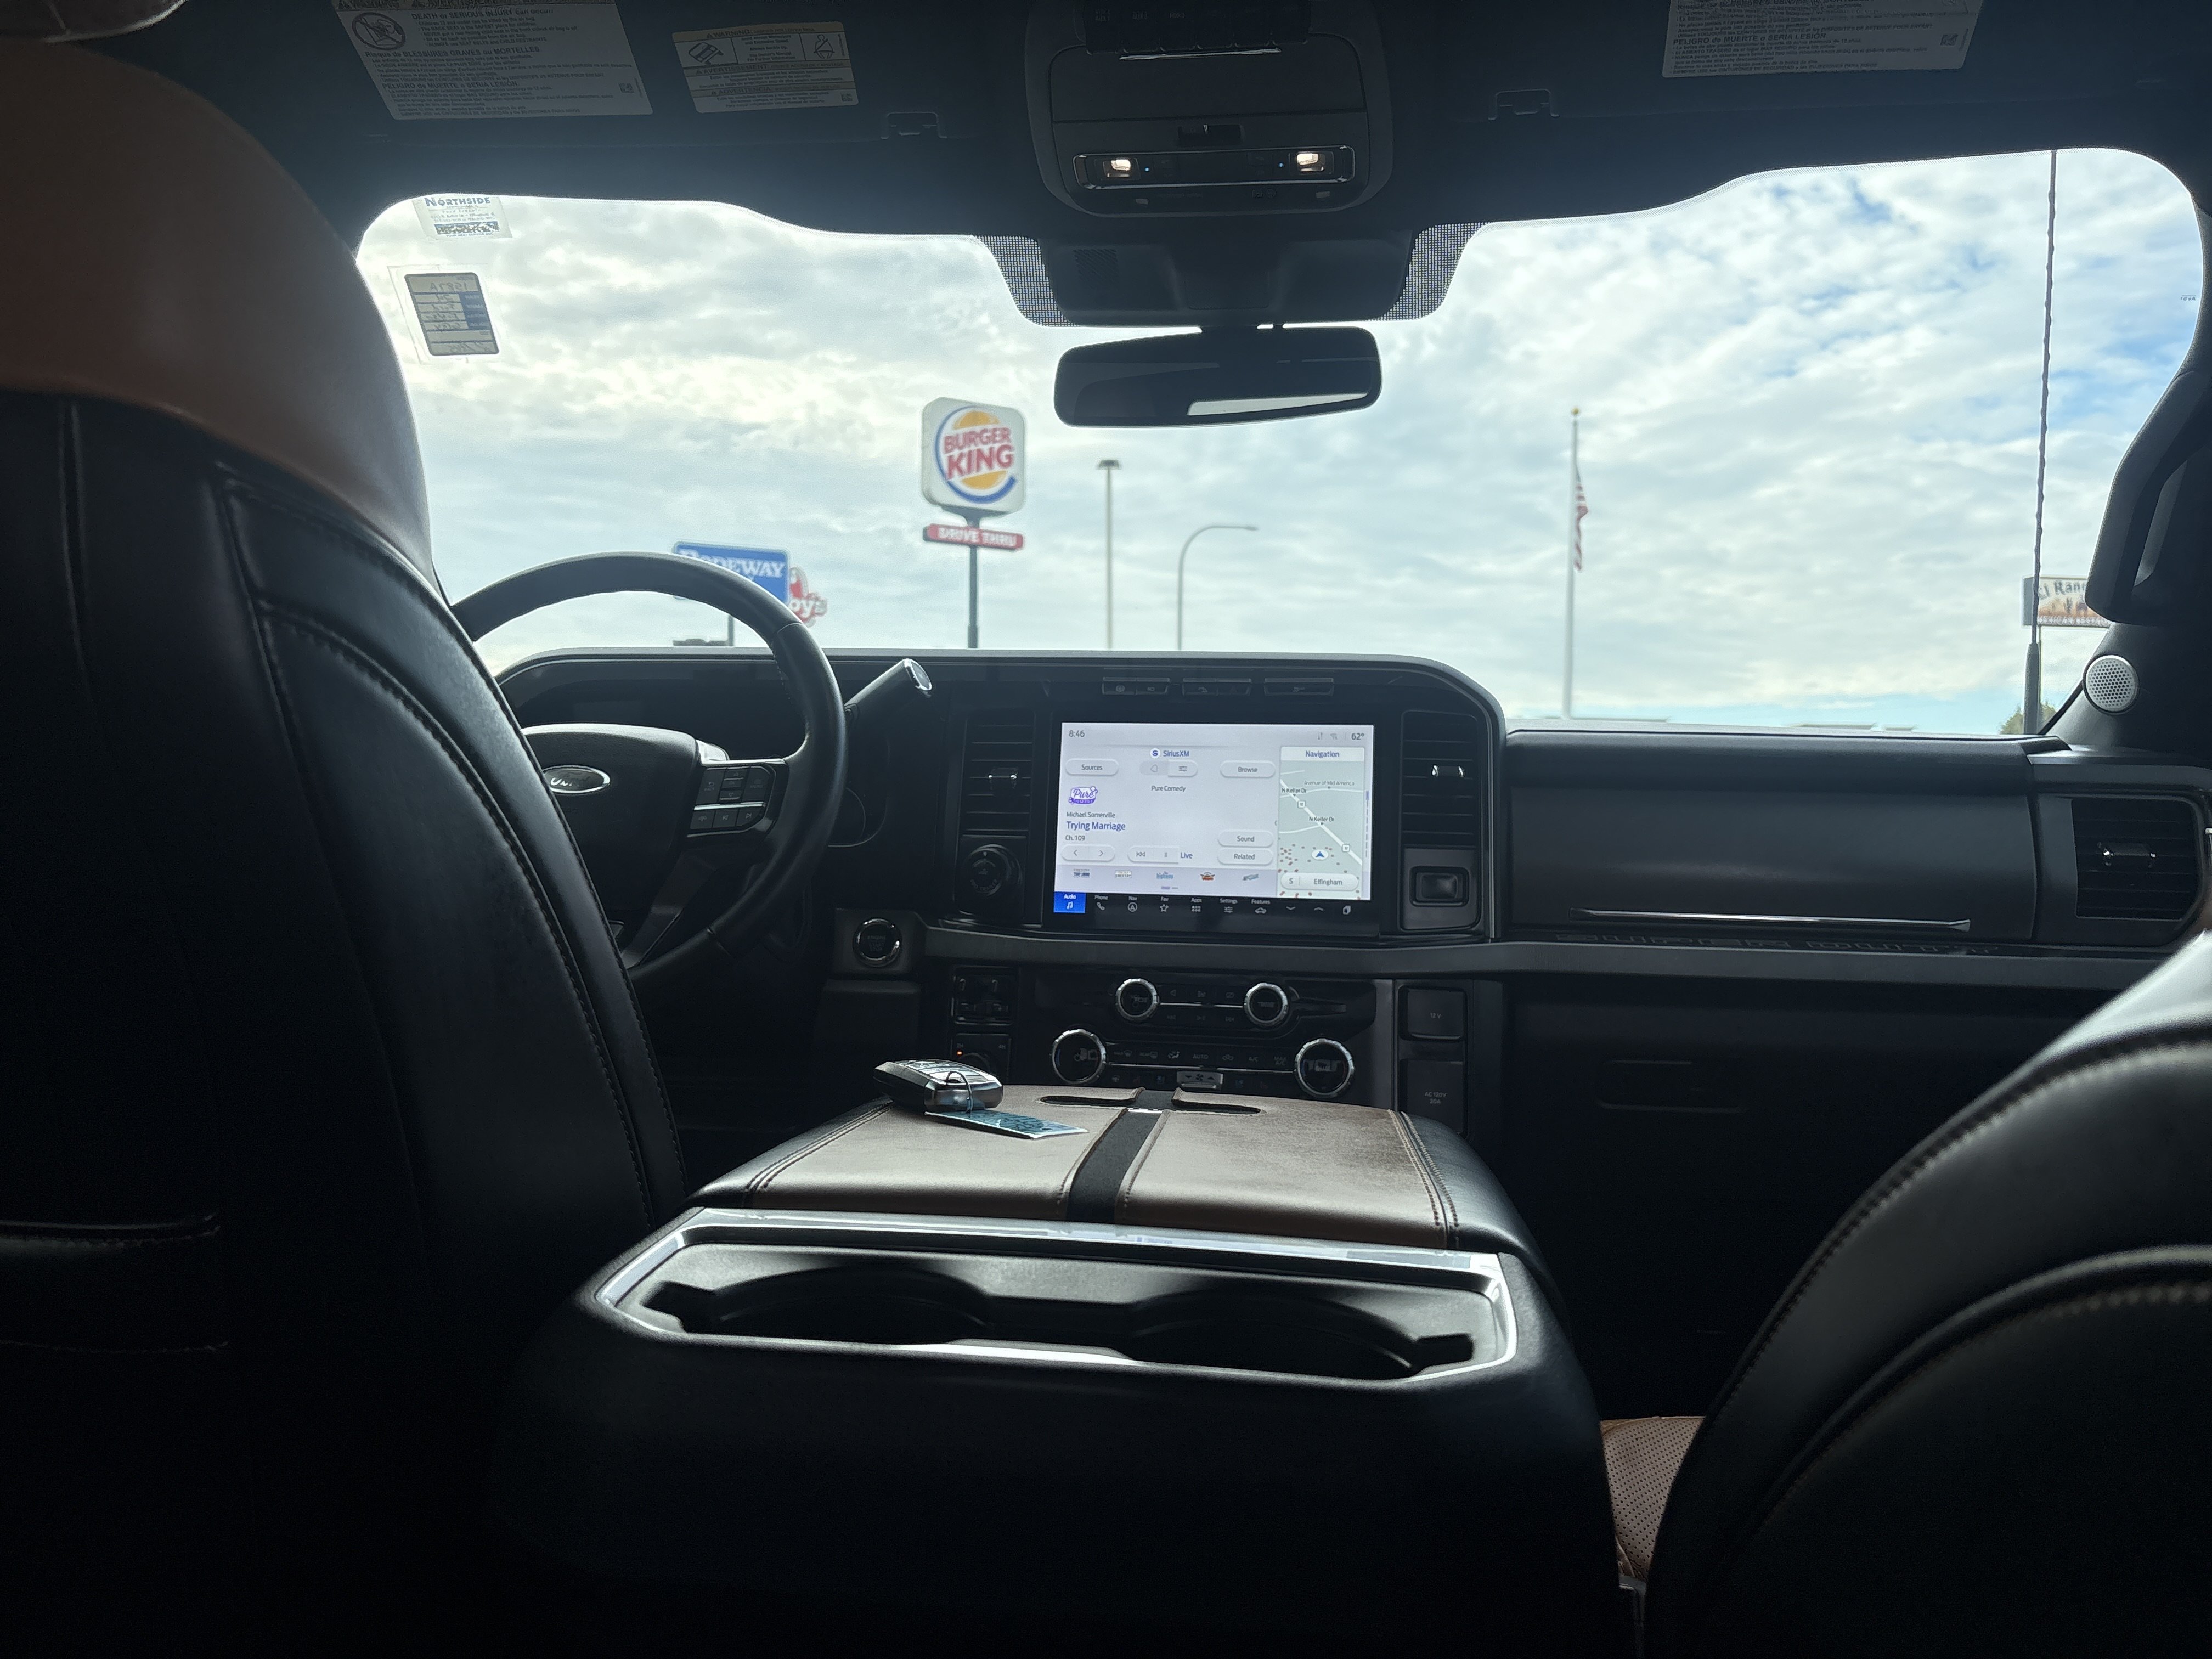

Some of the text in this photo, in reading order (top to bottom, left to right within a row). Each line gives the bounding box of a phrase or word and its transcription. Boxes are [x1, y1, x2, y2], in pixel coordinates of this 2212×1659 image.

[494, 46, 540, 55] MORTELLES
[424, 197, 491, 207] NORTHSIDE
[944, 427, 1011, 454] BURGER
[946, 444, 1014, 481] KING
[1073, 788, 1094, 798] Pure
[1066, 821, 1126, 831] Trying Marriage
